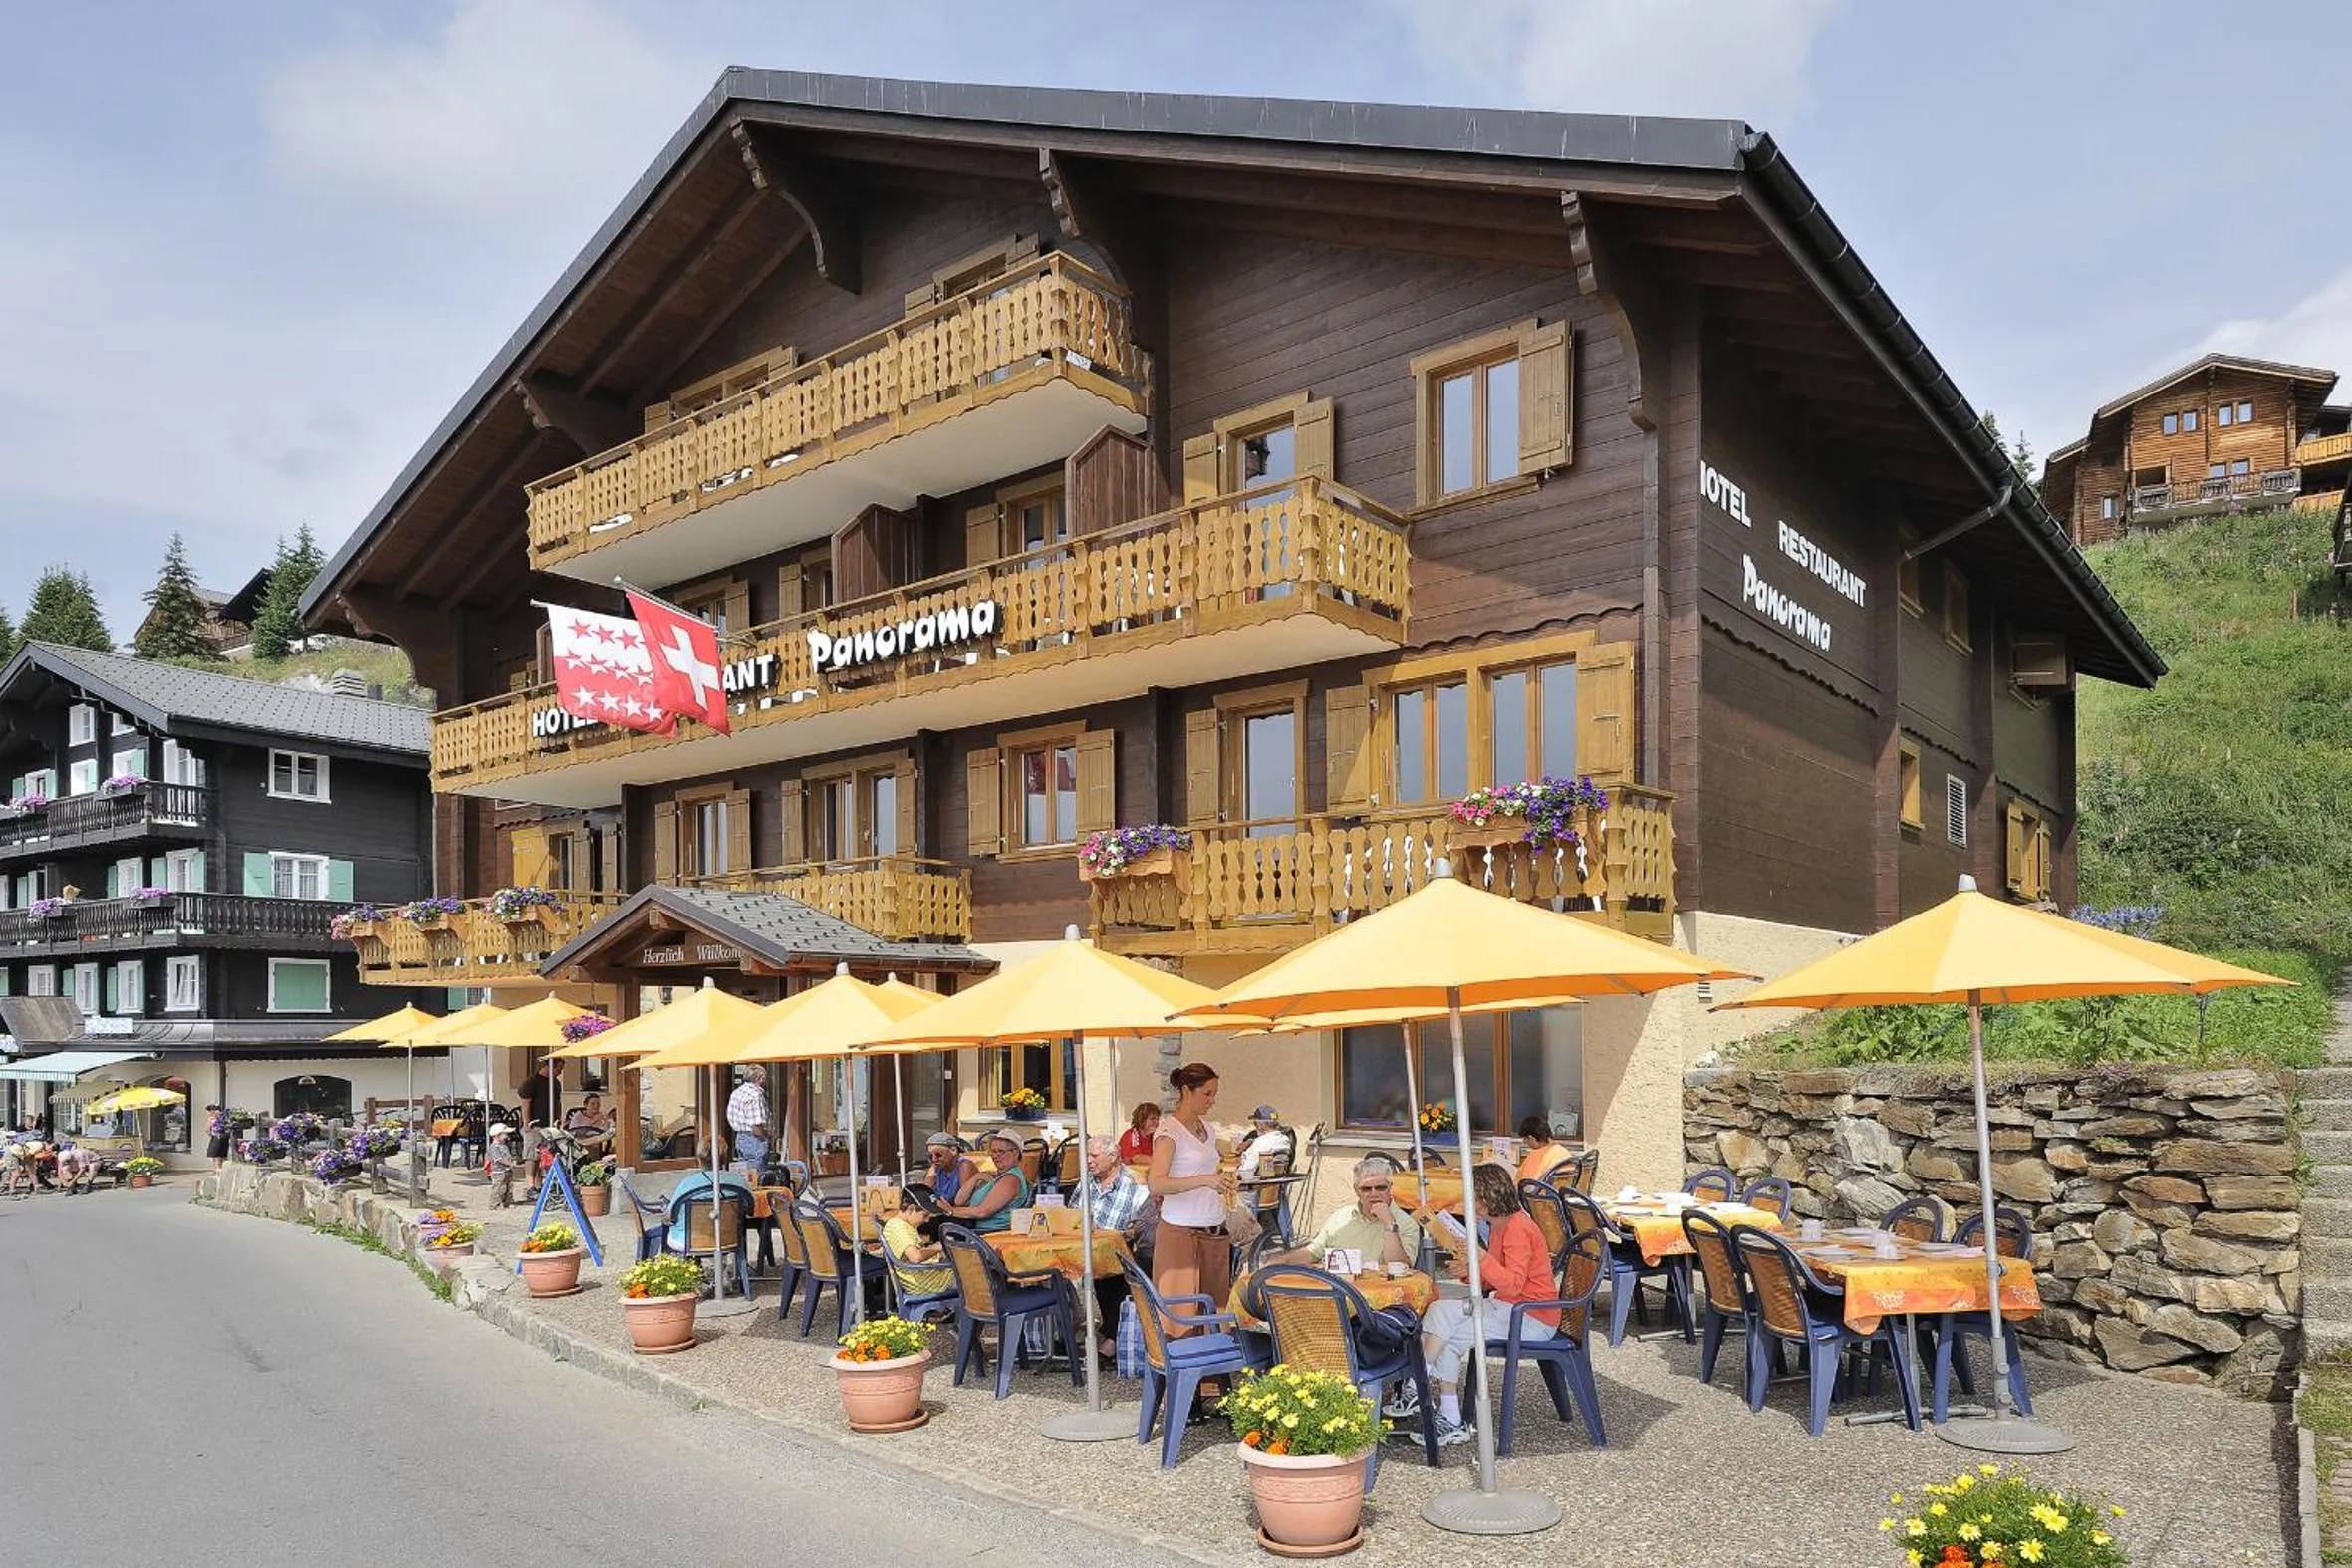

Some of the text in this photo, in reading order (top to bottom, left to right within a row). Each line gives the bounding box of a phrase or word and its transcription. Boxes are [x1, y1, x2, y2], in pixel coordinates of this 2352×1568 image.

[1743, 553, 1831, 652] Panorama
[1778, 519, 1867, 608] RESTAURANT
[532, 600, 995, 737] HOT ANT Panorama
[642, 945, 685, 964] Herzlich
